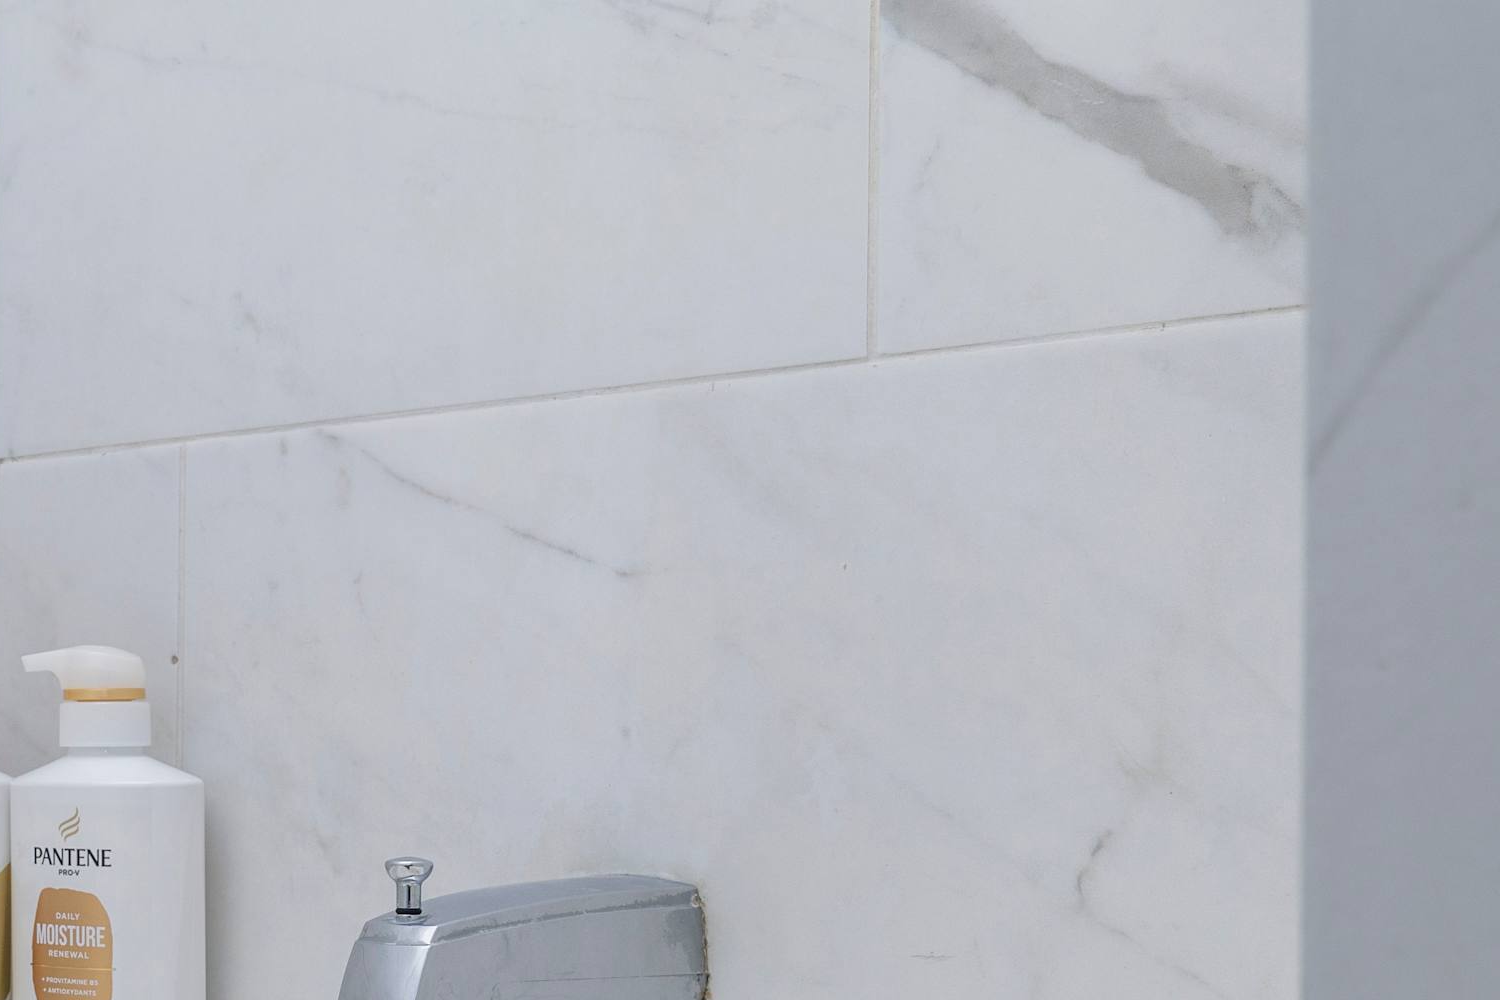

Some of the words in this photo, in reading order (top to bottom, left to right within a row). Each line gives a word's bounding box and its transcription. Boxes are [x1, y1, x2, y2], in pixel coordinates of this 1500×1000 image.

[33, 846, 112, 868] PANTENE
[55, 911, 80, 920] DAILY
[36, 922, 106, 948] MOISTURE
[48, 949, 90, 960] RENEWAL
